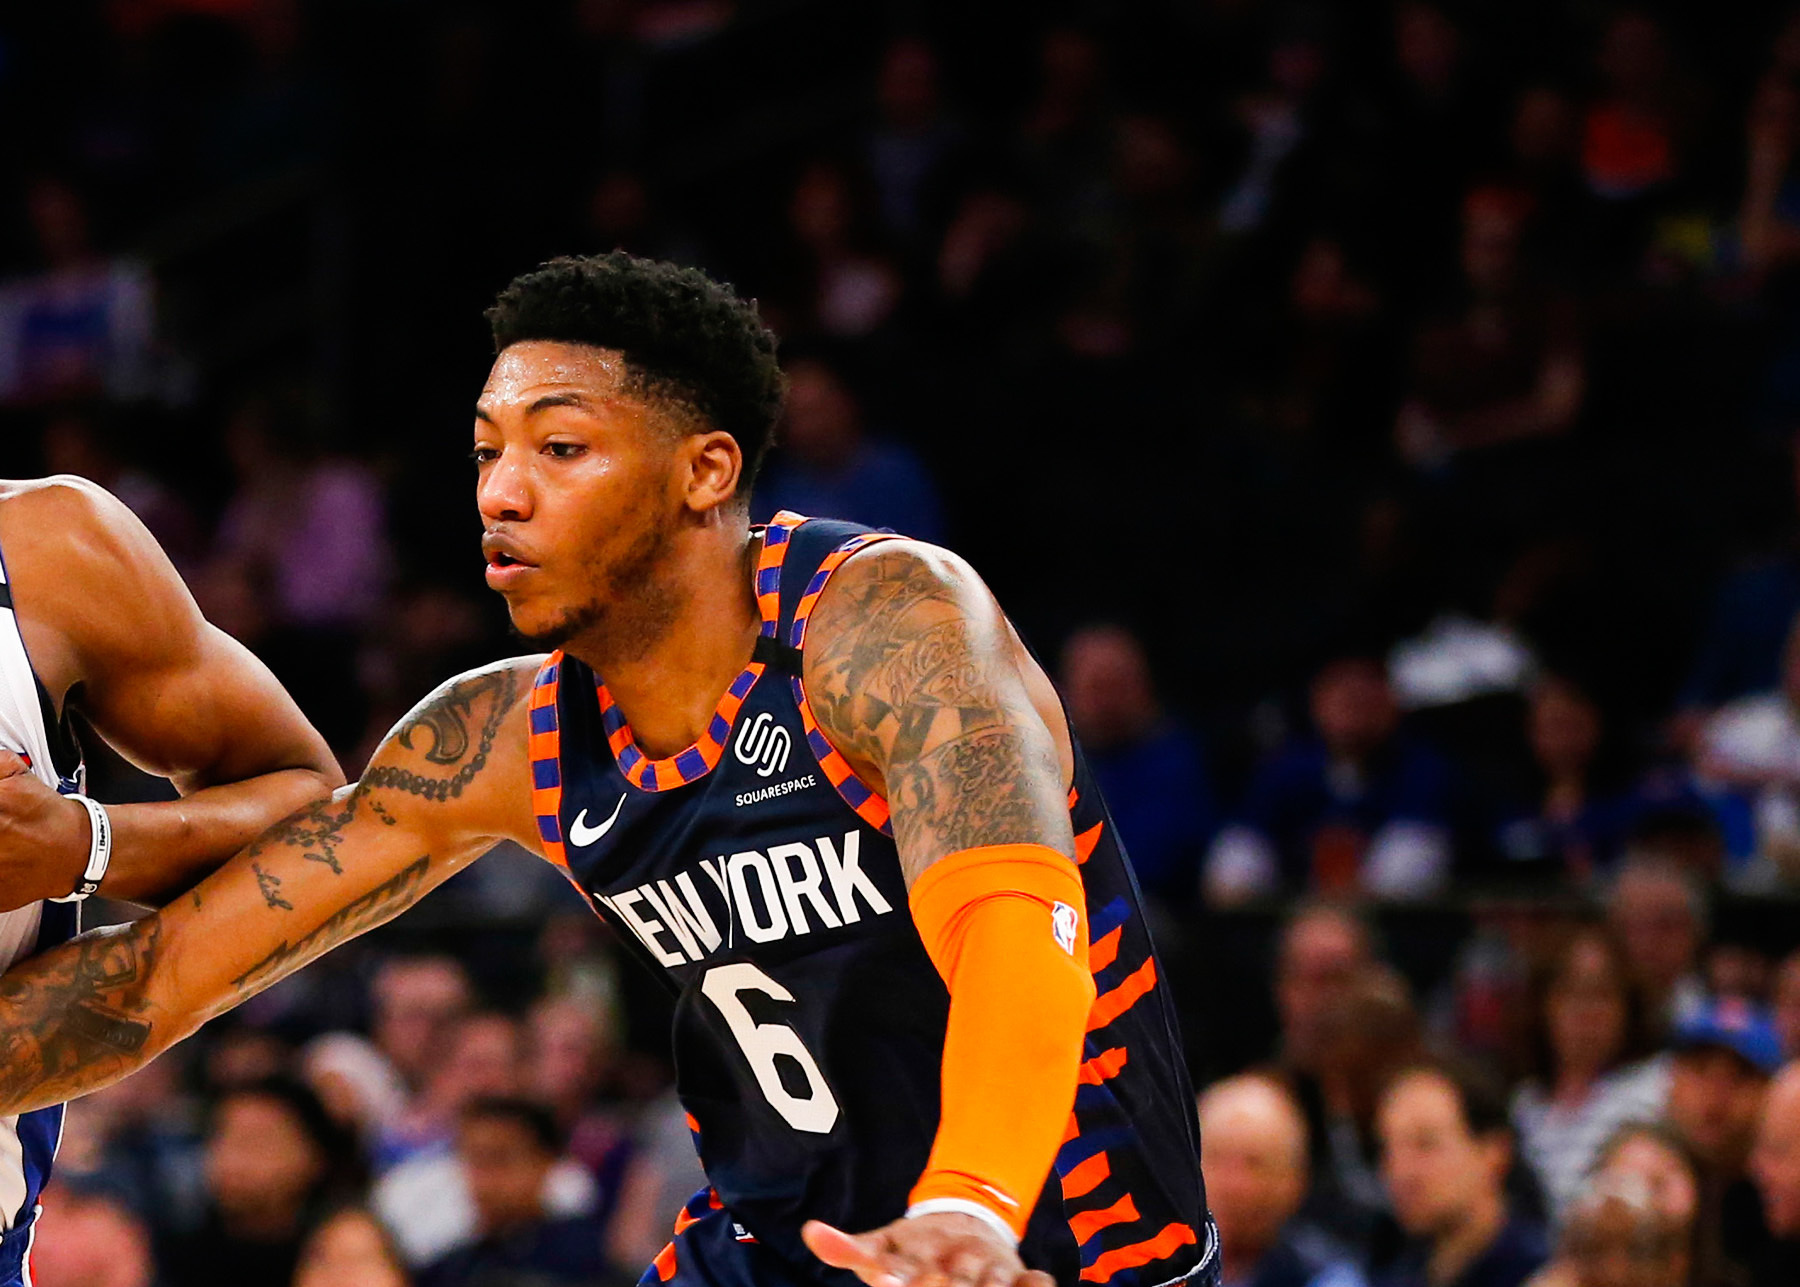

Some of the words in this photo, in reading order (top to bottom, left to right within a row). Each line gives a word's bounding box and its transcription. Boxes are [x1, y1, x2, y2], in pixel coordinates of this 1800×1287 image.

[735, 774, 817, 807] SQUARESPACE
[593, 871, 723, 968] EW
[699, 829, 894, 949] YORK
[701, 962, 839, 1134] 6
